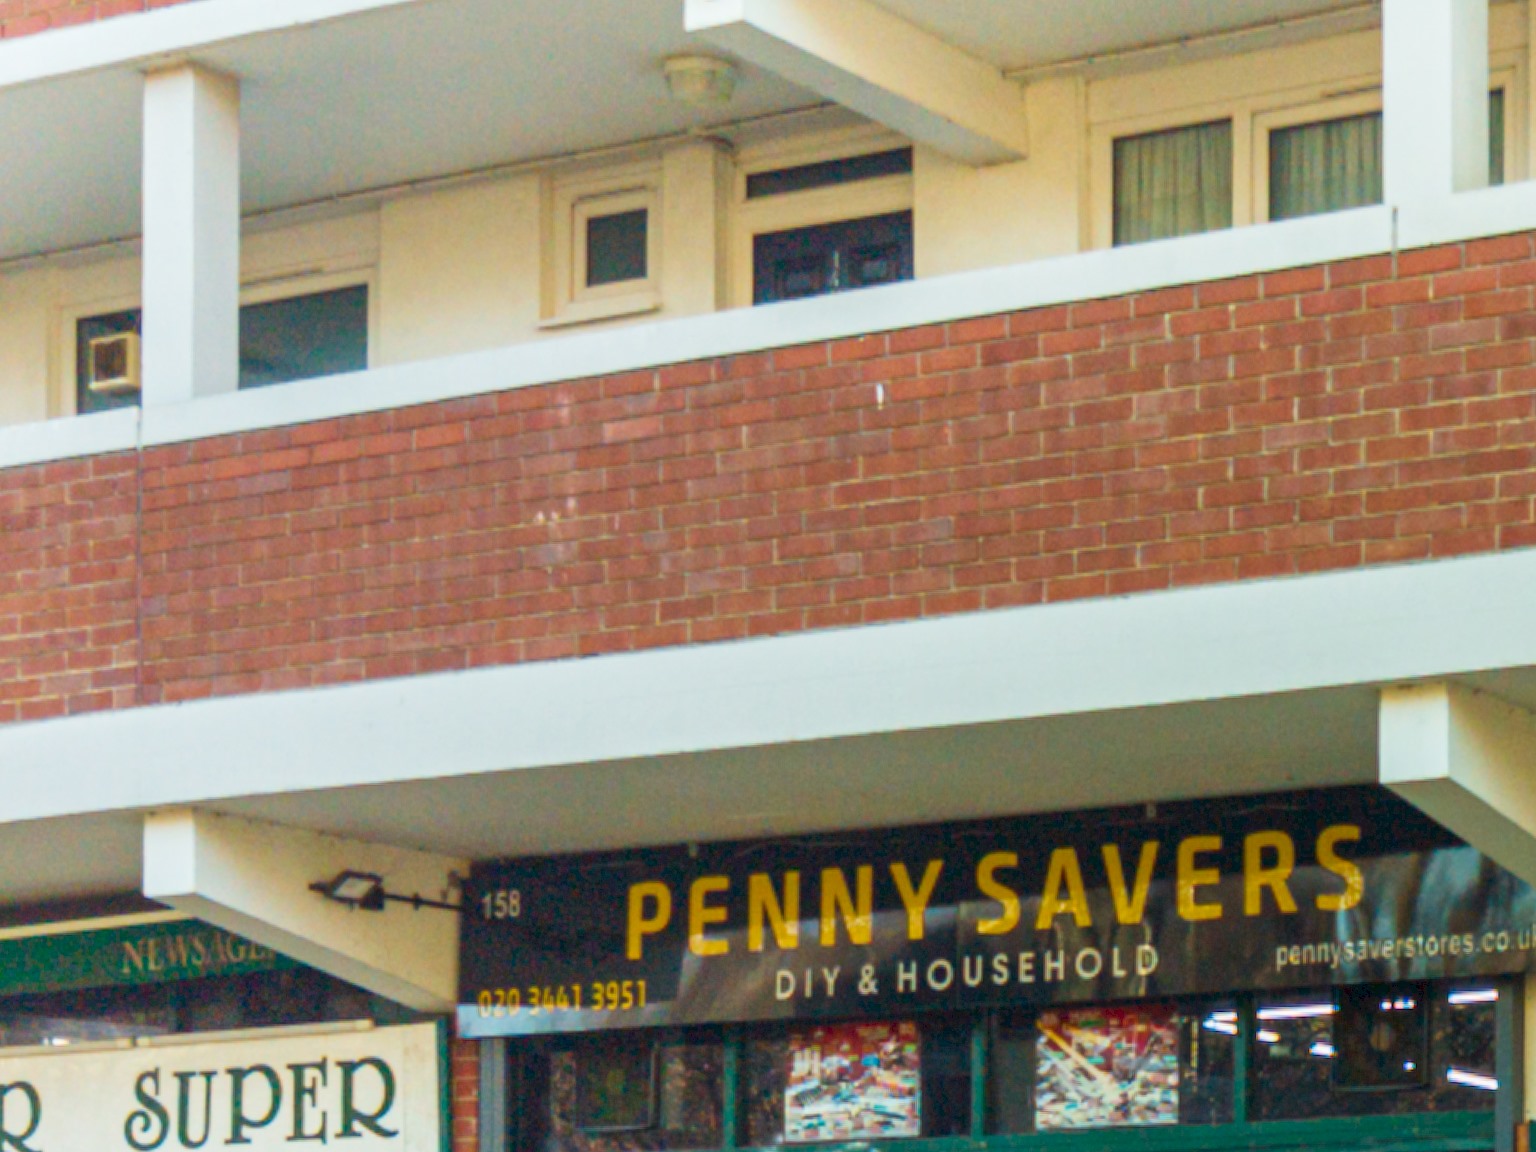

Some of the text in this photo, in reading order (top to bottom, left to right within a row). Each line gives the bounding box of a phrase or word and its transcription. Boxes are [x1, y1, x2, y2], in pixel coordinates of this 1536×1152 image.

[482, 889, 521, 920] 158
[625, 823, 1366, 961] PENNY SAVERS
[478, 986, 521, 1018] 020
[591, 978, 647, 1012] 3951
[775, 945, 1160, 1001] DIY & HOUSEHOLD
[123, 1055, 400, 1152] SUPER
